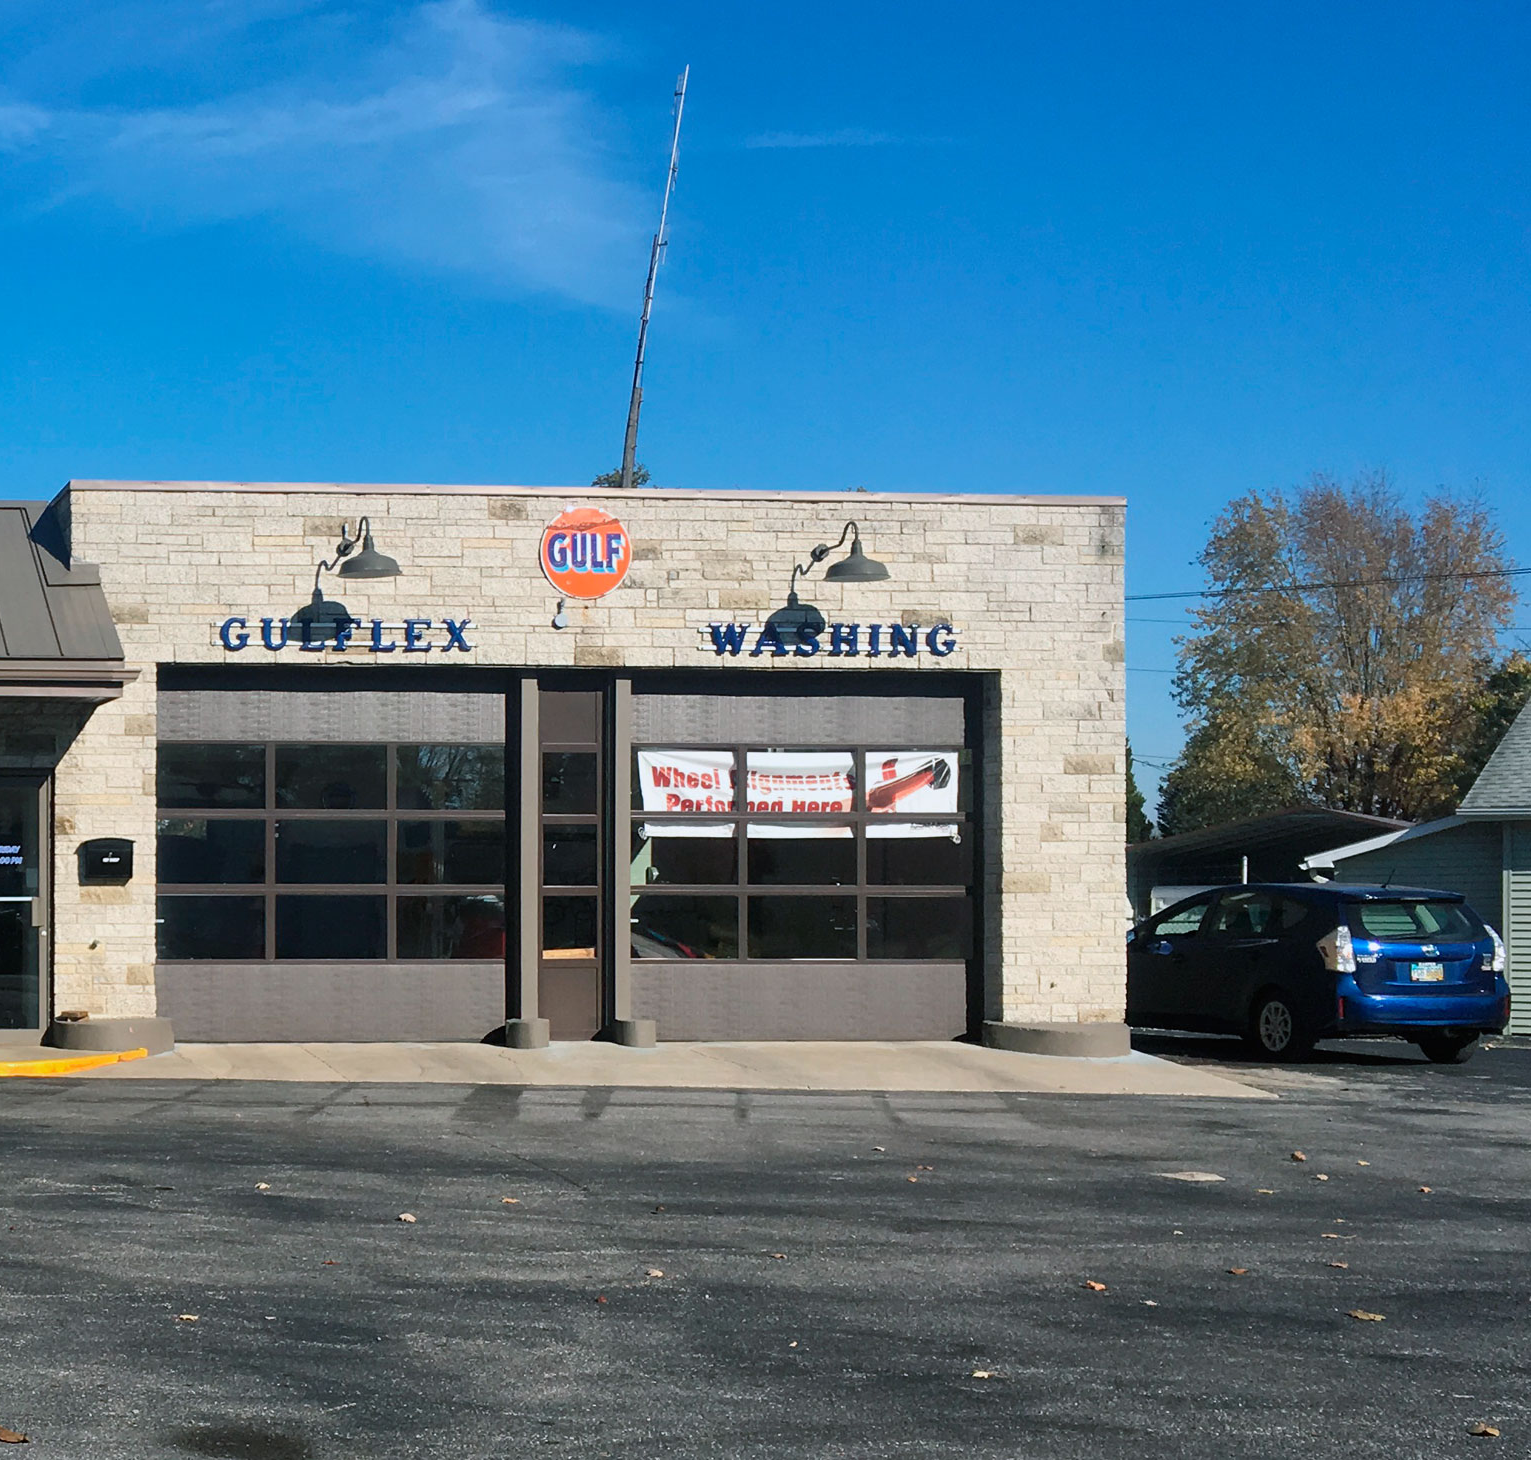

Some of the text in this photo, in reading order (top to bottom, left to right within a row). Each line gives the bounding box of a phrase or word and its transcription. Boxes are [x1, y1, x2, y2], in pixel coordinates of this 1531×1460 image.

[548, 532, 625, 573] GULF
[219, 616, 472, 653] GULFLEX
[707, 622, 958, 658] WASHING
[651, 765, 721, 789] Wheel
[791, 799, 843, 812] Here
